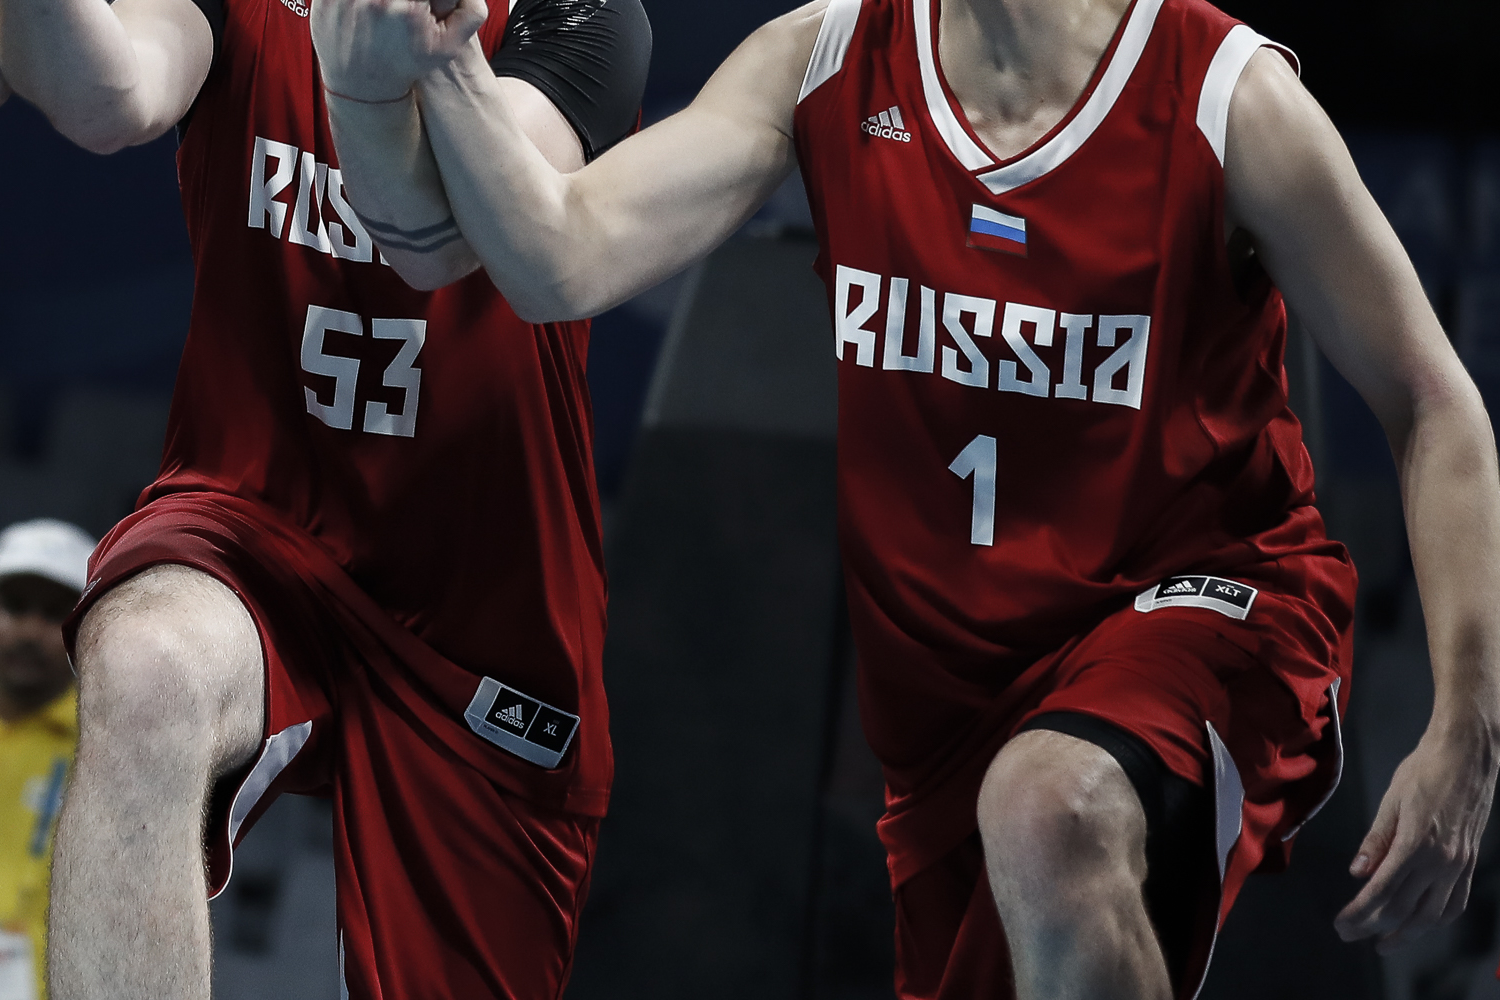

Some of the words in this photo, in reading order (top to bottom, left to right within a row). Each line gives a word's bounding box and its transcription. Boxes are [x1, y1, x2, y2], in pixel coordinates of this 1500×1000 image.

[861, 121, 911, 143] adidas
[247, 135, 390, 267] RUS
[300, 304, 427, 438] 53
[835, 264, 1151, 411] RUSSIA
[947, 434, 998, 546] 1
[1215, 584, 1242, 597] XLT
[495, 712, 525, 729] adidas
[543, 722, 556, 736] XL
